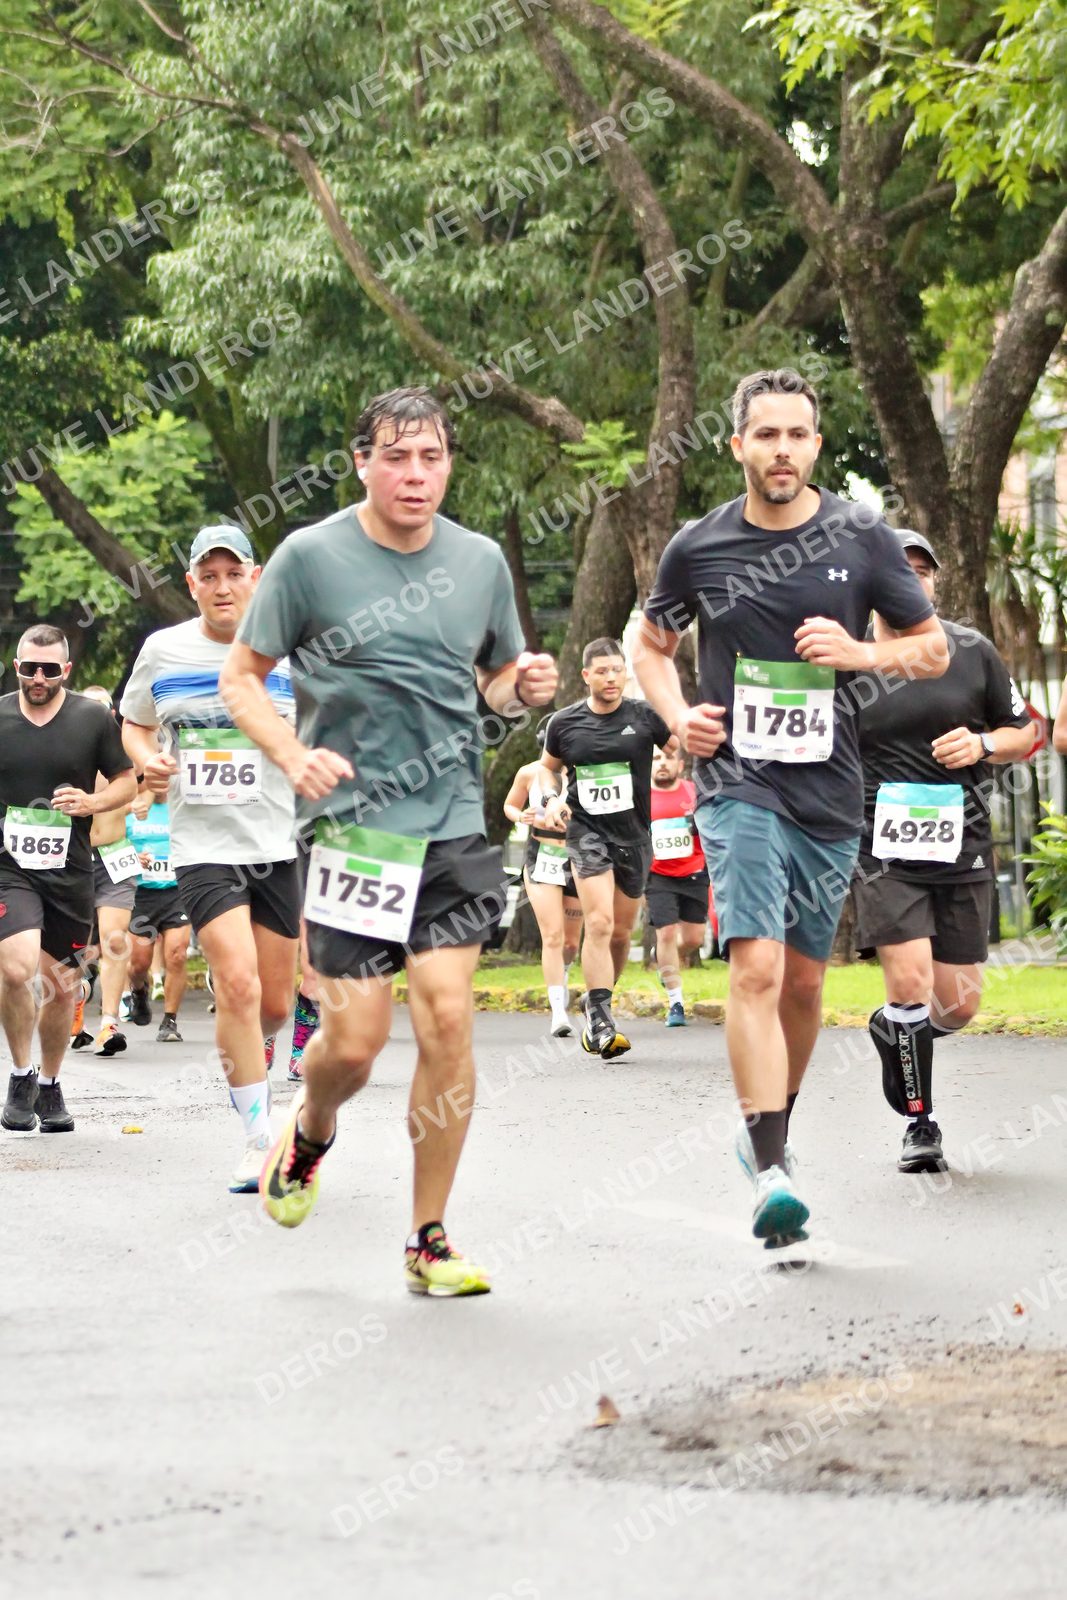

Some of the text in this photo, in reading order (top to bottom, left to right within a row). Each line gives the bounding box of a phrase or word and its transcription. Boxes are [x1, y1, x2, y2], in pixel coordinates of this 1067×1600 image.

[743, 704, 827, 738] 1784
[187, 763, 256, 786] 1786
[588, 785, 621, 803] 701
[880, 819, 955, 844] 4928
[9, 834, 65, 855] 1863
[655, 835, 691, 850] 6380
[109, 853, 138, 872] 163
[541, 861, 563, 875] 13
[319, 867, 406, 915] 1752
